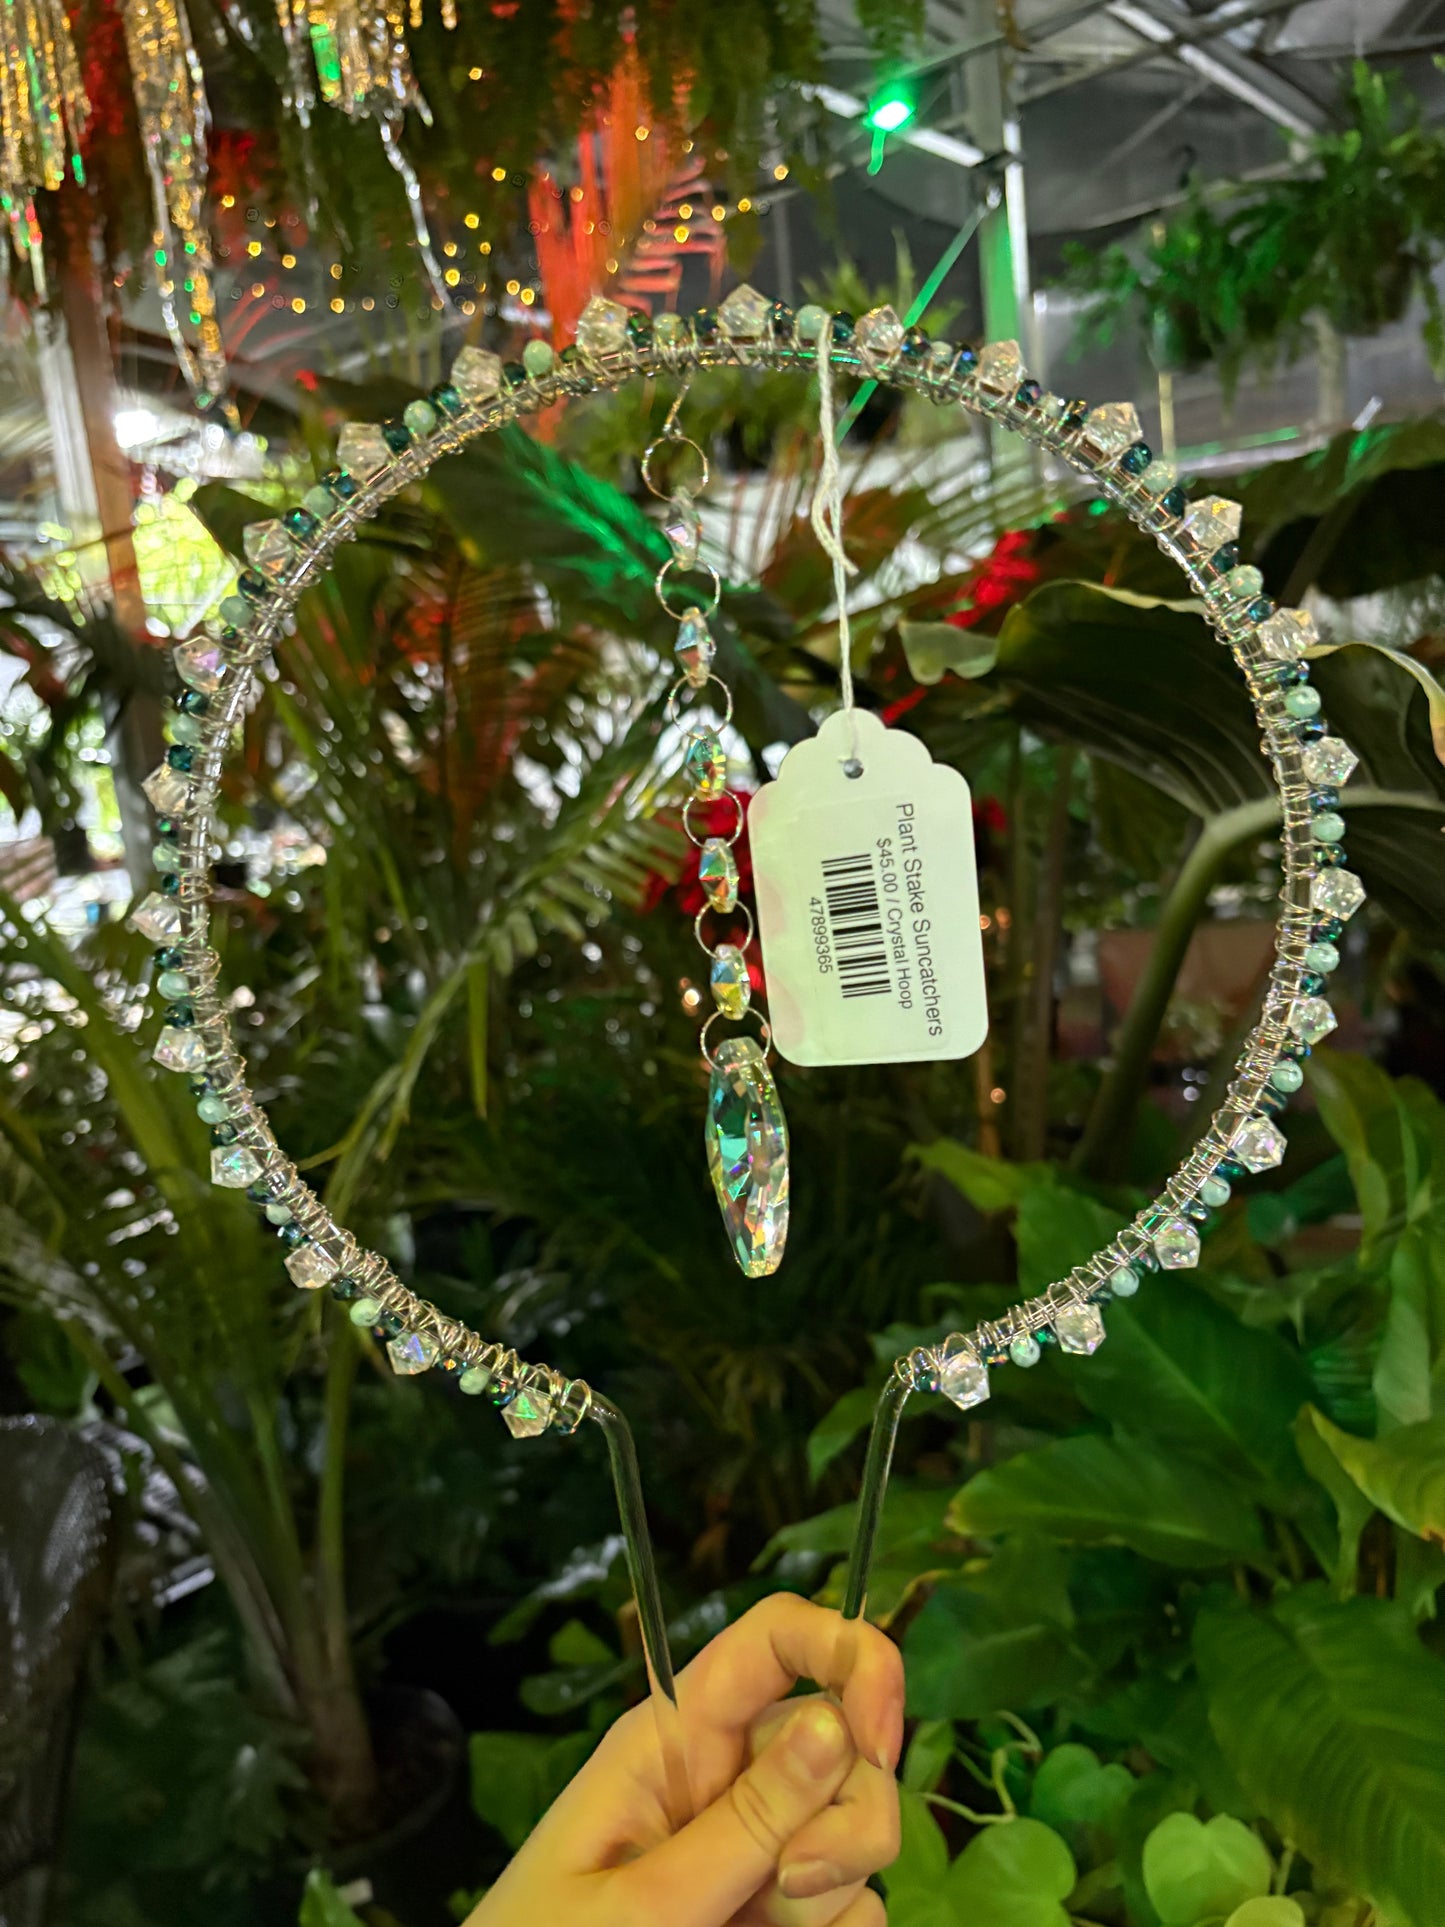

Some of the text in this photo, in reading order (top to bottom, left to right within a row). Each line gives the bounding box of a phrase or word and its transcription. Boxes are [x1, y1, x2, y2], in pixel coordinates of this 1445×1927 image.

[876, 838, 899, 893] $45.00
[810, 896, 833, 974] 47899365
[886, 908, 909, 964] Crystal
[896, 803, 943, 1037] Plant Stake Suncatchers
[897, 968, 913, 1010] Hoop
